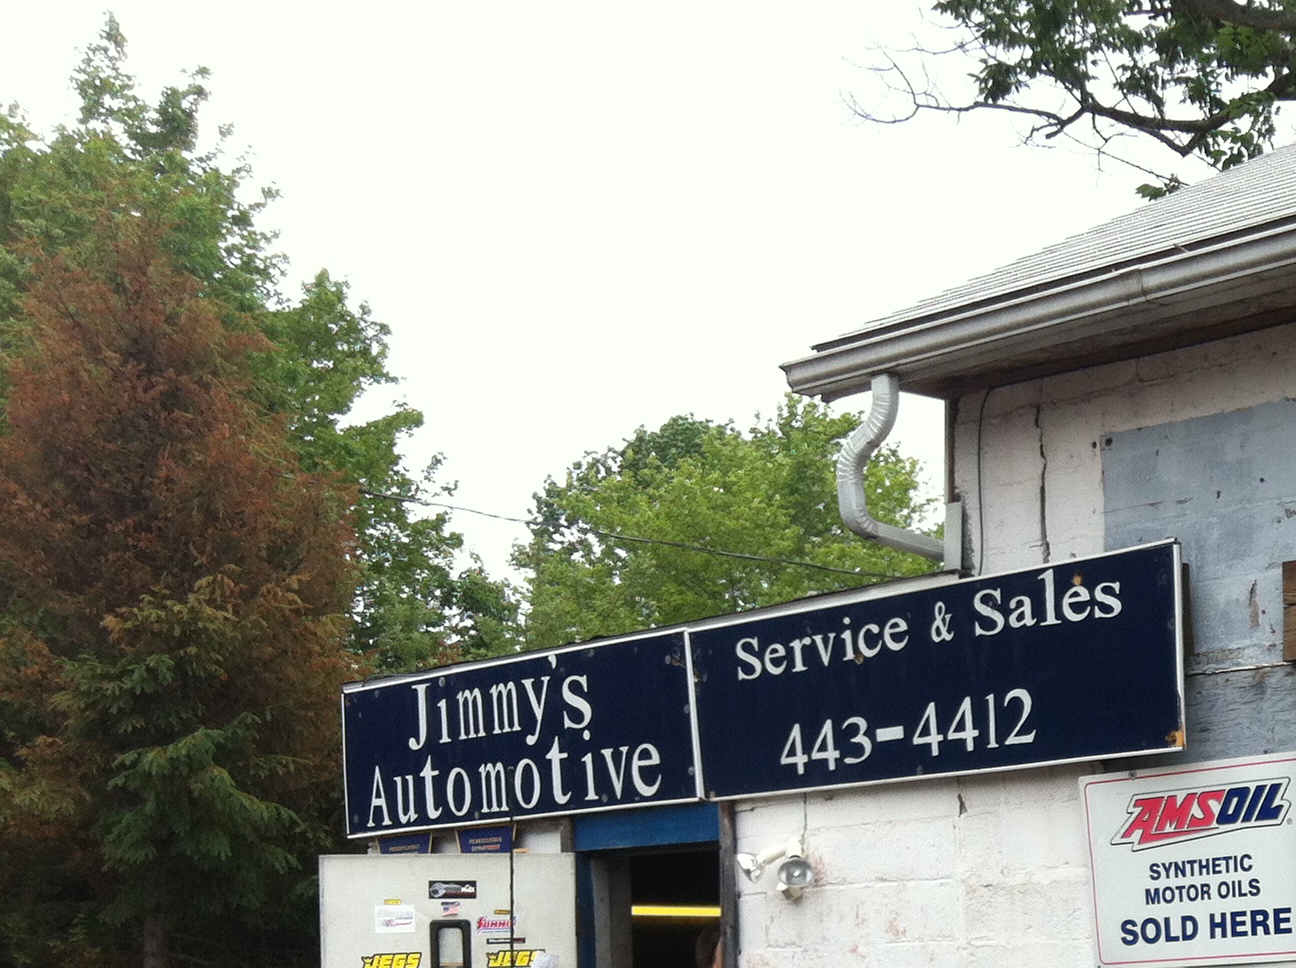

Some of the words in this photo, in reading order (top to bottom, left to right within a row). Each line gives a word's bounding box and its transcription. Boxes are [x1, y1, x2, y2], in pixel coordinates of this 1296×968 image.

[735, 617, 909, 681] Service
[930, 601, 954, 643] &
[974, 569, 1123, 637] Sales
[408, 654, 593, 750] Jimmy's
[780, 688, 1037, 775] 443-4412
[367, 729, 662, 828] Automotive
[1120, 782, 1285, 845] AMSOIL
[1145, 883, 1212, 906] MOTOR
[1217, 878, 1261, 900] OILS
[1149, 854, 1253, 881] SYNTHETIC
[1120, 915, 1199, 946] SOLD
[1209, 907, 1293, 939] HERE
